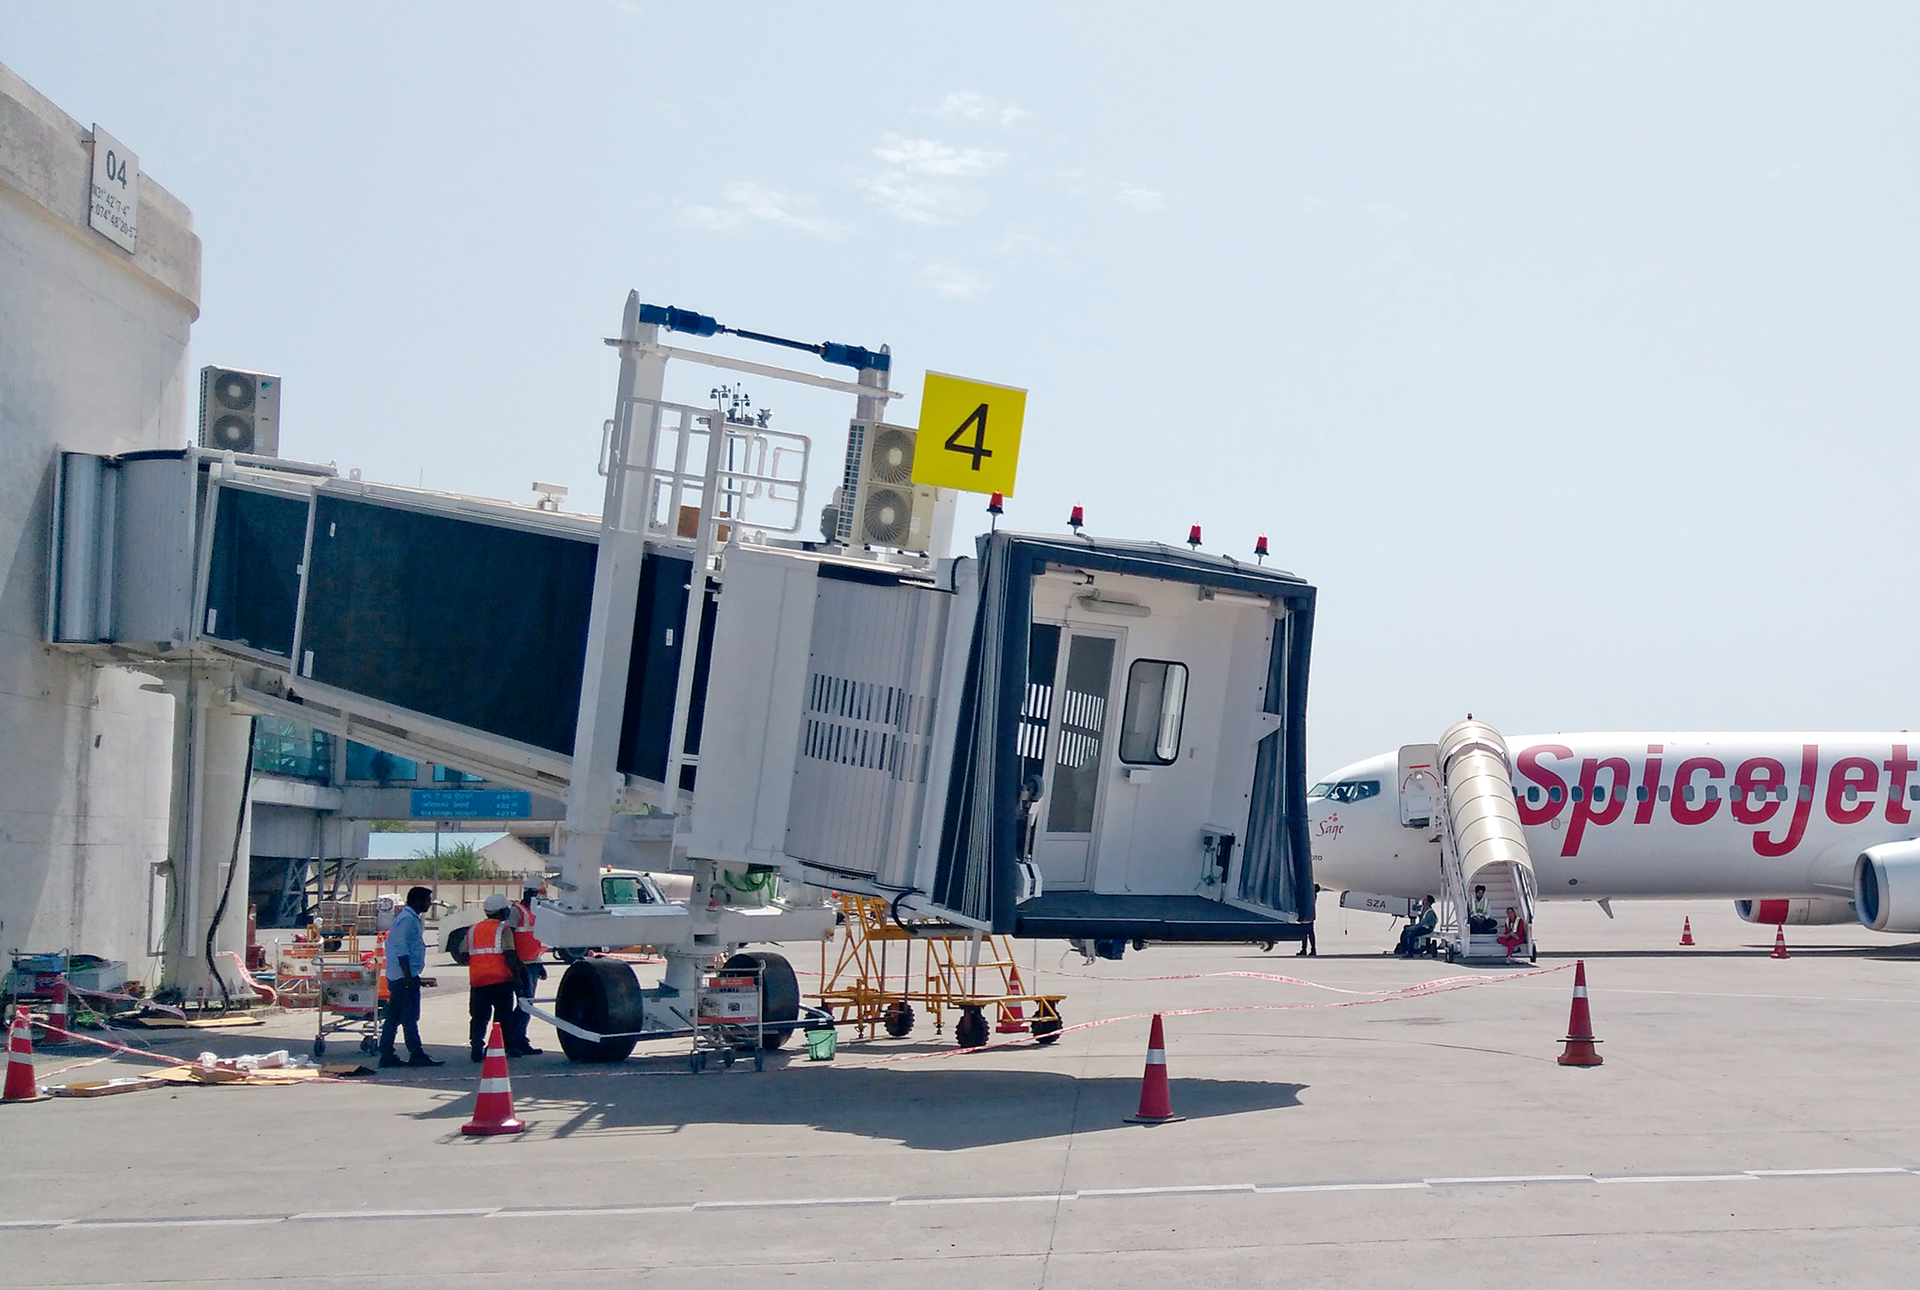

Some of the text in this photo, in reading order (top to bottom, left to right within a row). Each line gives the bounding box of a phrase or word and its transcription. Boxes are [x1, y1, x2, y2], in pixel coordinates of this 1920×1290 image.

[106, 149, 128, 190] 04
[944, 402, 993, 472] 4
[1516, 743, 1918, 857] SpiceJet
[1366, 898, 1387, 908] SZA
